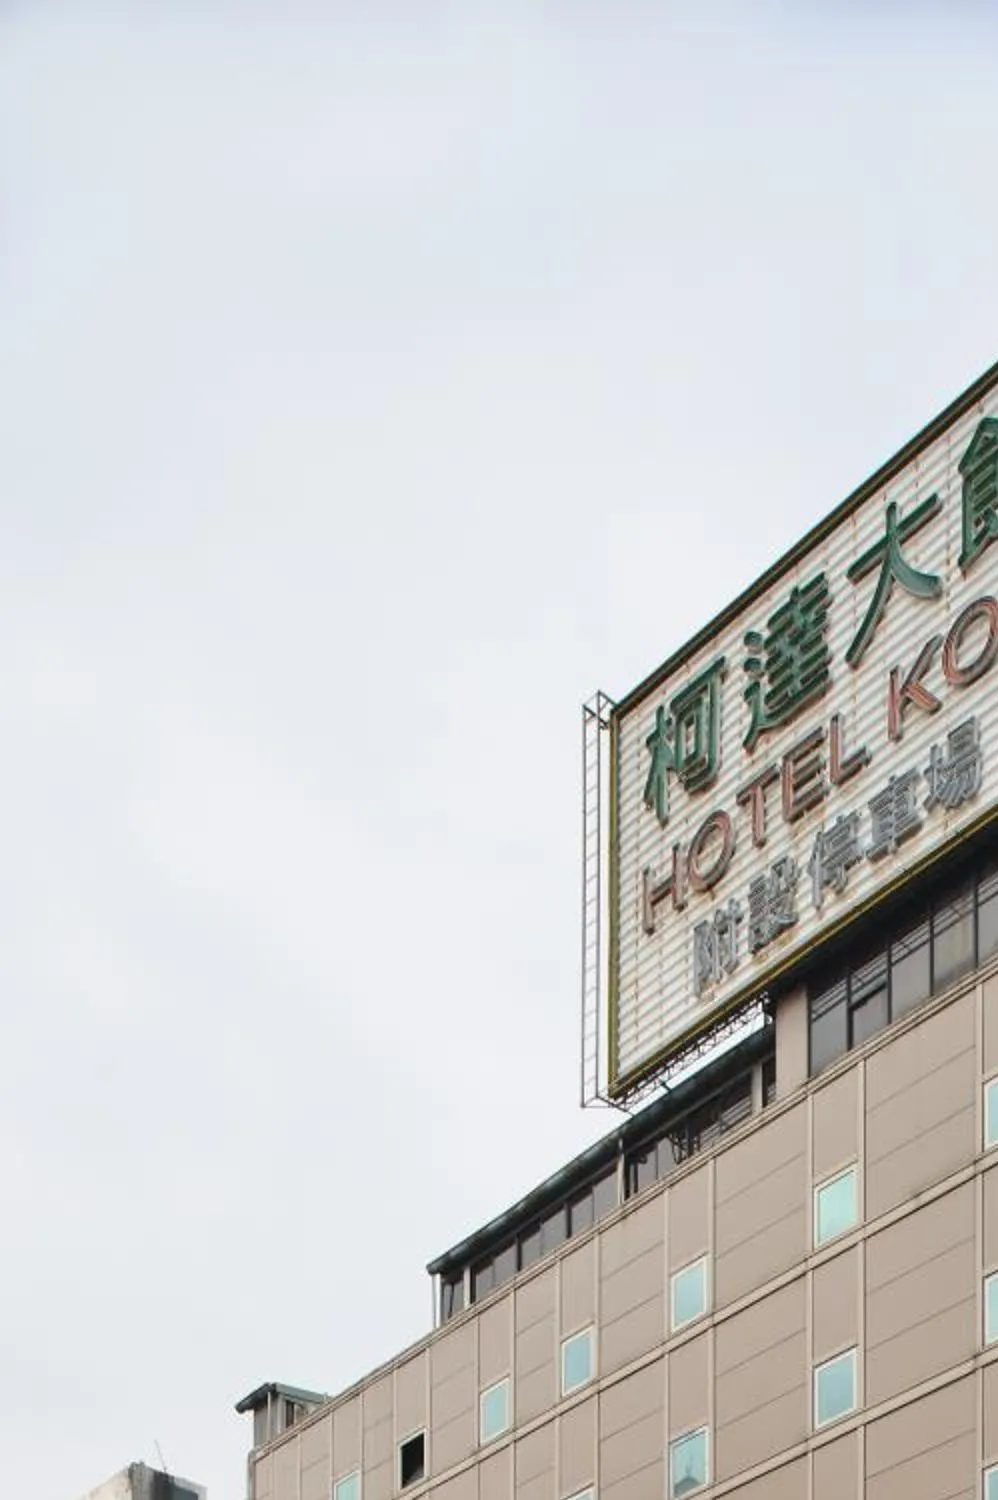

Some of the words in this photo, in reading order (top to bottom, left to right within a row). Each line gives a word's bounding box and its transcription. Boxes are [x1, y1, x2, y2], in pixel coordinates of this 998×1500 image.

[643, 712, 872, 936] HOTEL
[693, 716, 983, 998] 附設停車場
